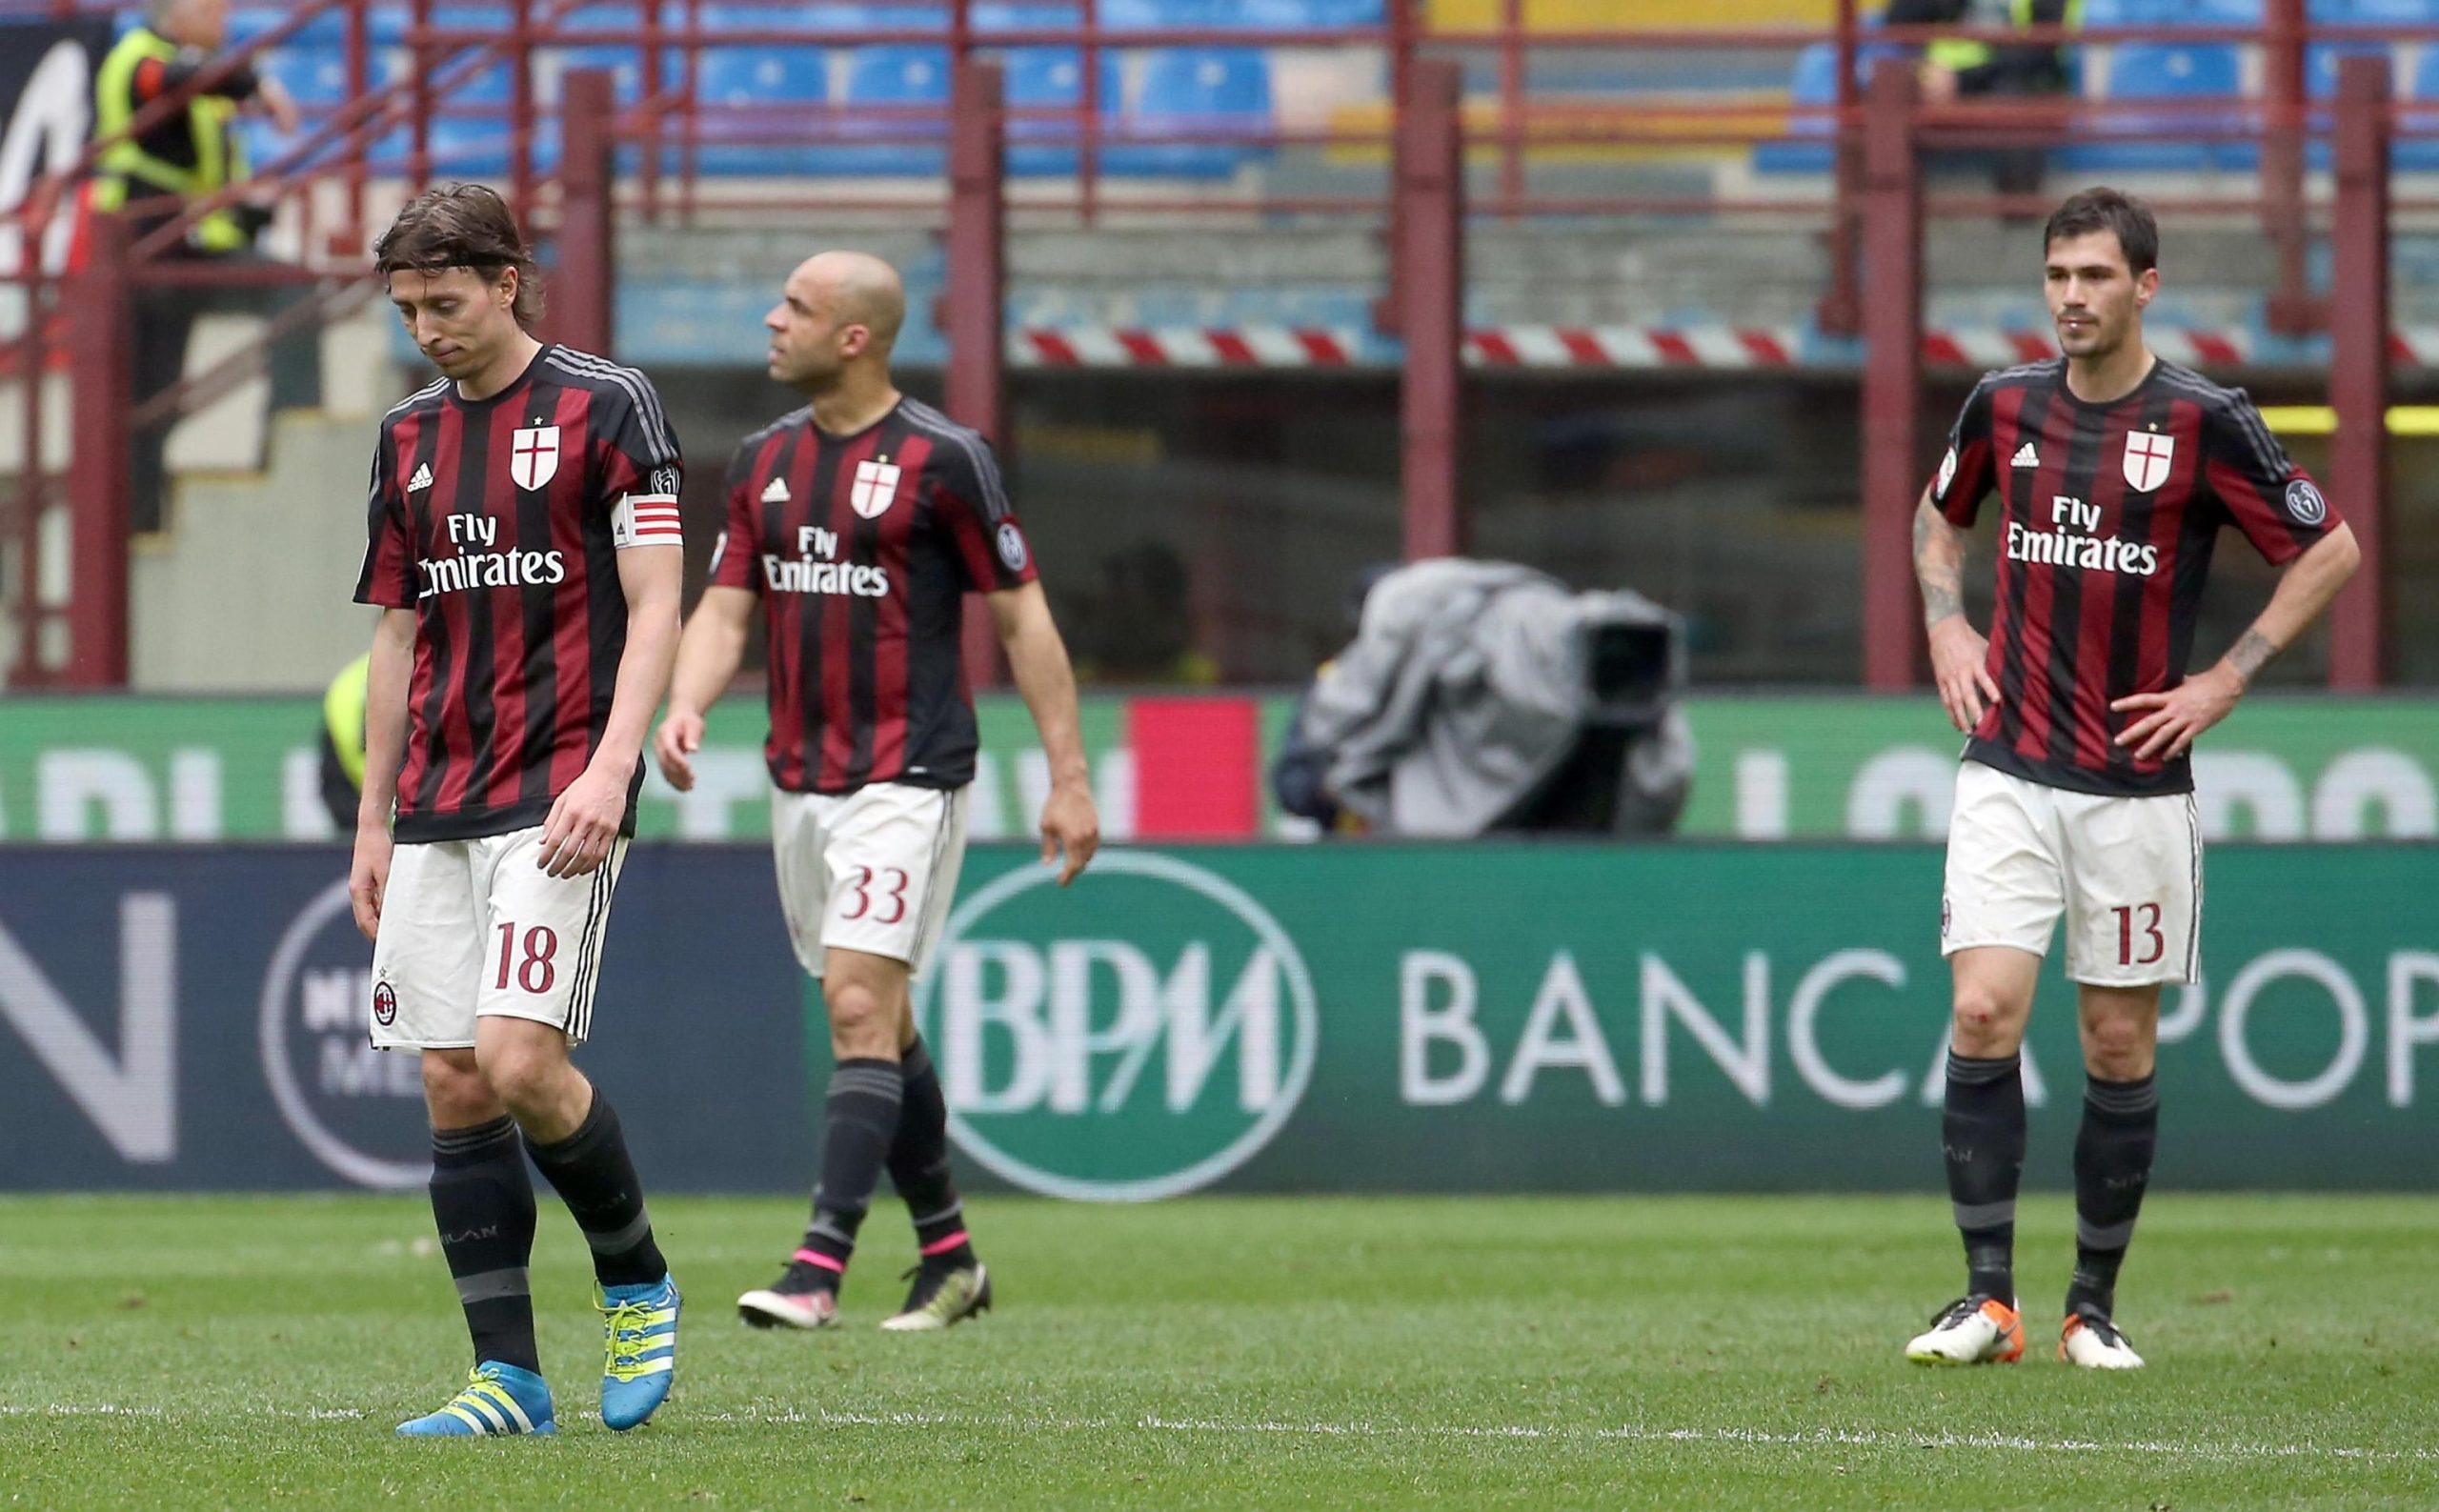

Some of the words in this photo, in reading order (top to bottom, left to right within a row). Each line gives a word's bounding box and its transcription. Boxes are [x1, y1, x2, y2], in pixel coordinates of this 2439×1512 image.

[447, 513, 496, 547] Fly
[2052, 495, 2102, 533] Fly
[798, 526, 837, 560] Fly
[2006, 521, 2157, 575] Emirates
[763, 554, 889, 597] Emirates
[839, 864, 908, 924] 33
[495, 921, 557, 994] 18
[2110, 902, 2164, 965] 13
[938, 939, 1282, 1115] BPM
